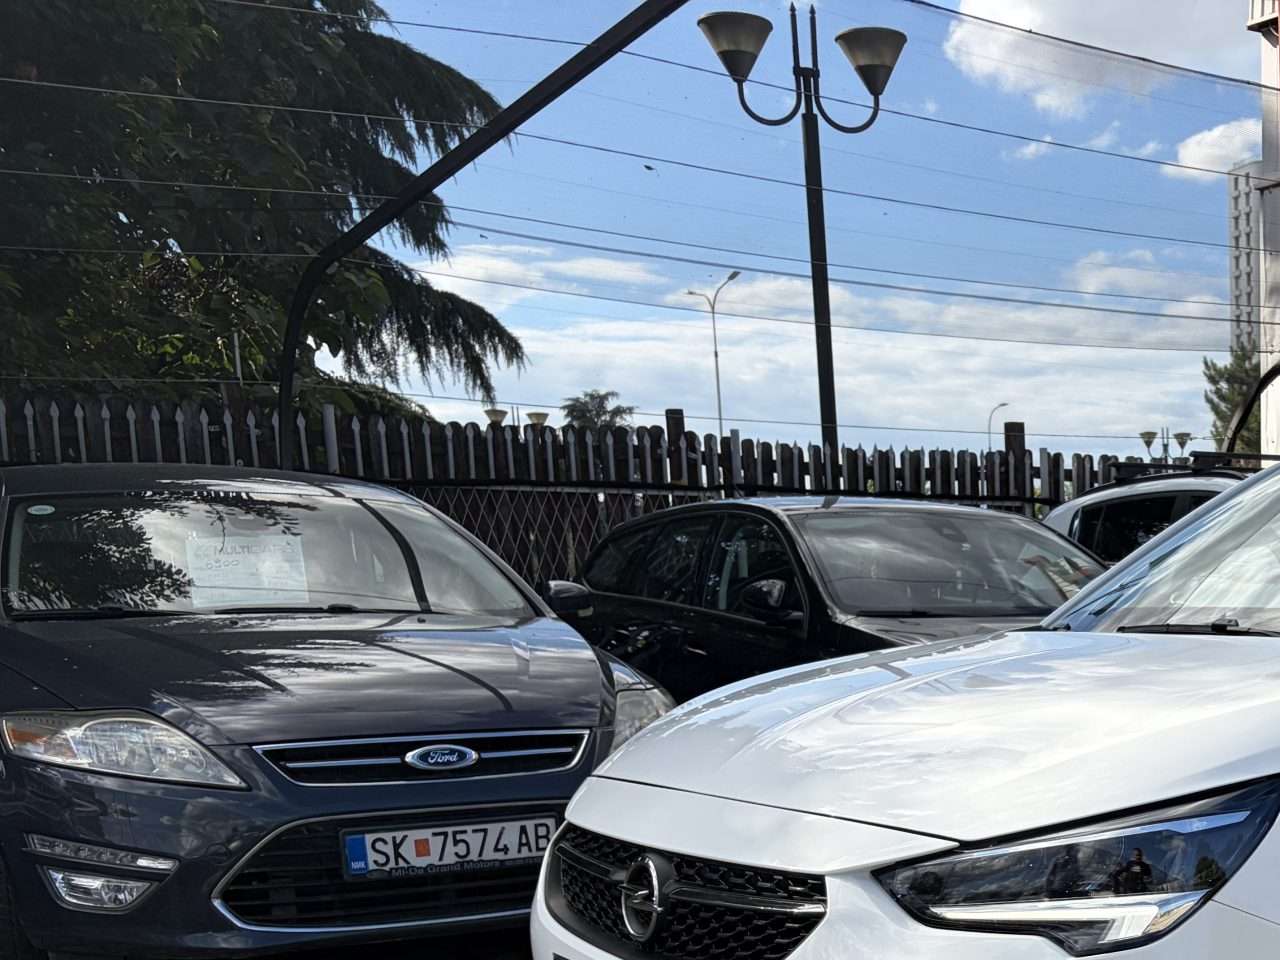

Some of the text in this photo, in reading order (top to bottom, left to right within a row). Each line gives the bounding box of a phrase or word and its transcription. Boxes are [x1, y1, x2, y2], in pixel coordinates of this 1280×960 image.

[428, 749, 458, 764] Ford
[370, 822, 551, 868] SK 7574 AB
